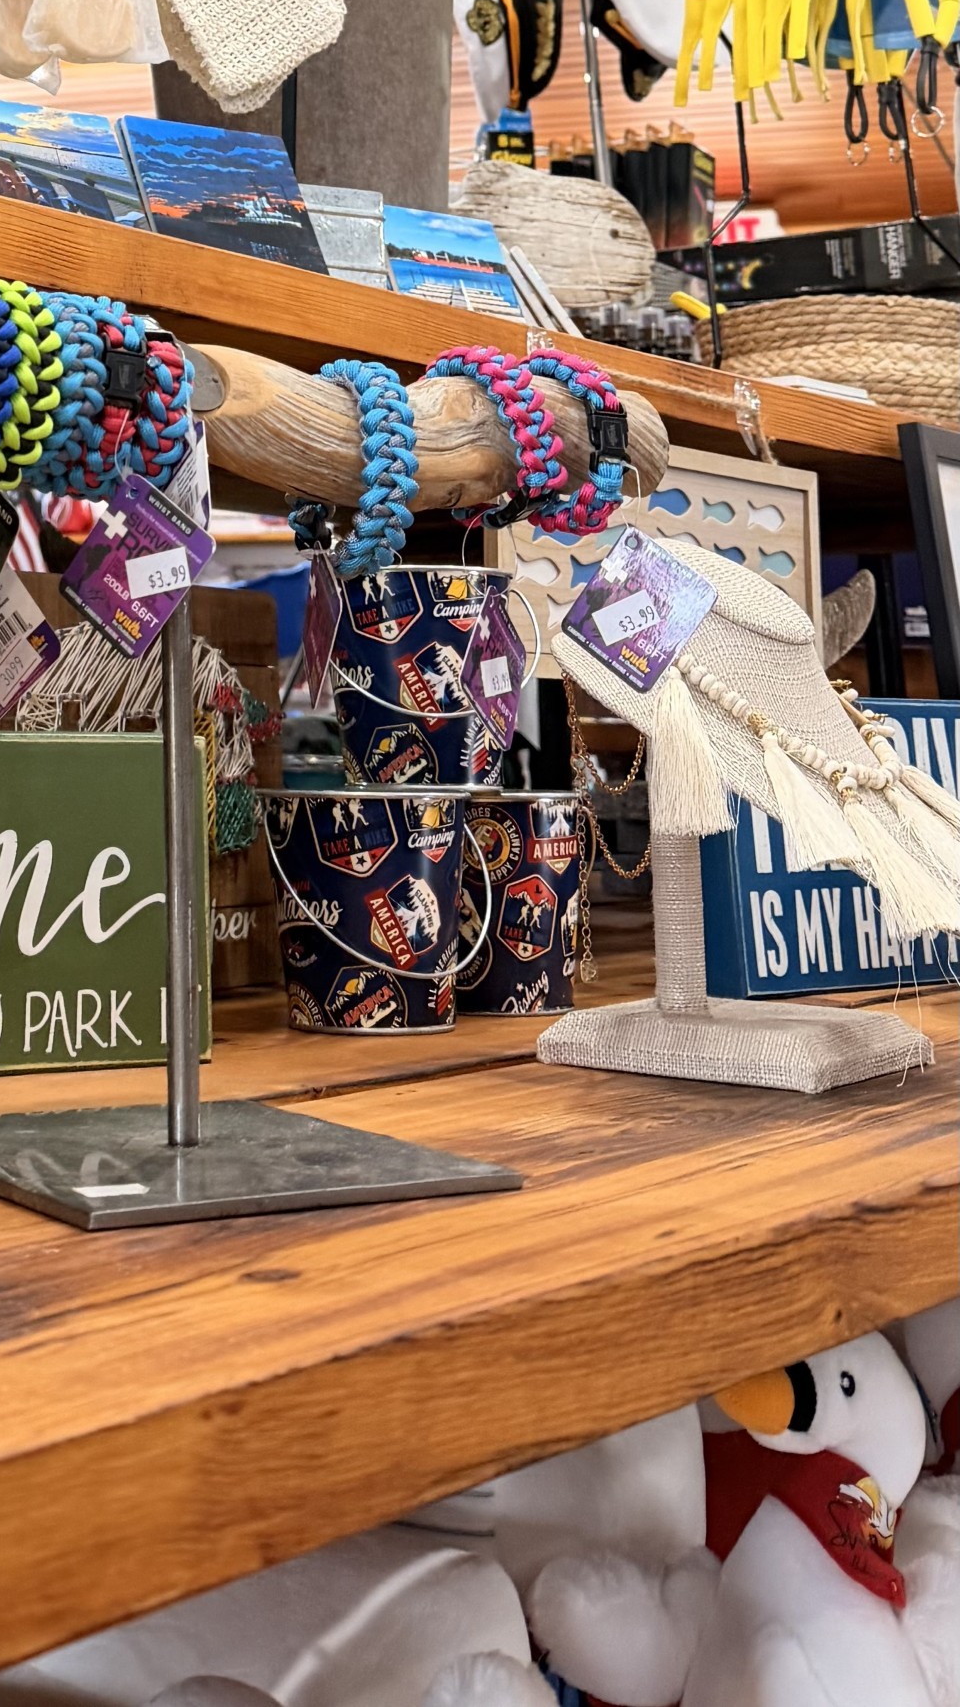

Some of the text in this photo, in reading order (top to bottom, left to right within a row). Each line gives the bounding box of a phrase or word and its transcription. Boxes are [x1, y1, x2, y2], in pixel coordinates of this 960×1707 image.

[147, 494, 193, 536] WRIST BAND
[148, 565, 187, 589] $3.99
[102, 573, 160, 629] 200LB 6.6FT
[382, 605, 390, 619] A
[619, 605, 656, 634] $3.99
[0, 655, 24, 687] 3099
[397, 661, 440, 727] AMERICA
[354, 834, 362, 850] A
[407, 827, 456, 850] Camping
[532, 839, 578, 861] AMERICA
[369, 897, 412, 967] AMERICA
[524, 929, 532, 943] A
[750, 889, 789, 979] IS
[795, 887, 844, 975] MY
[343, 985, 396, 1028] AMERICA
[428, 987, 438, 1009] ALL
[501, 970, 551, 1014] Fishing
[23, 988, 142, 1058] PARK
